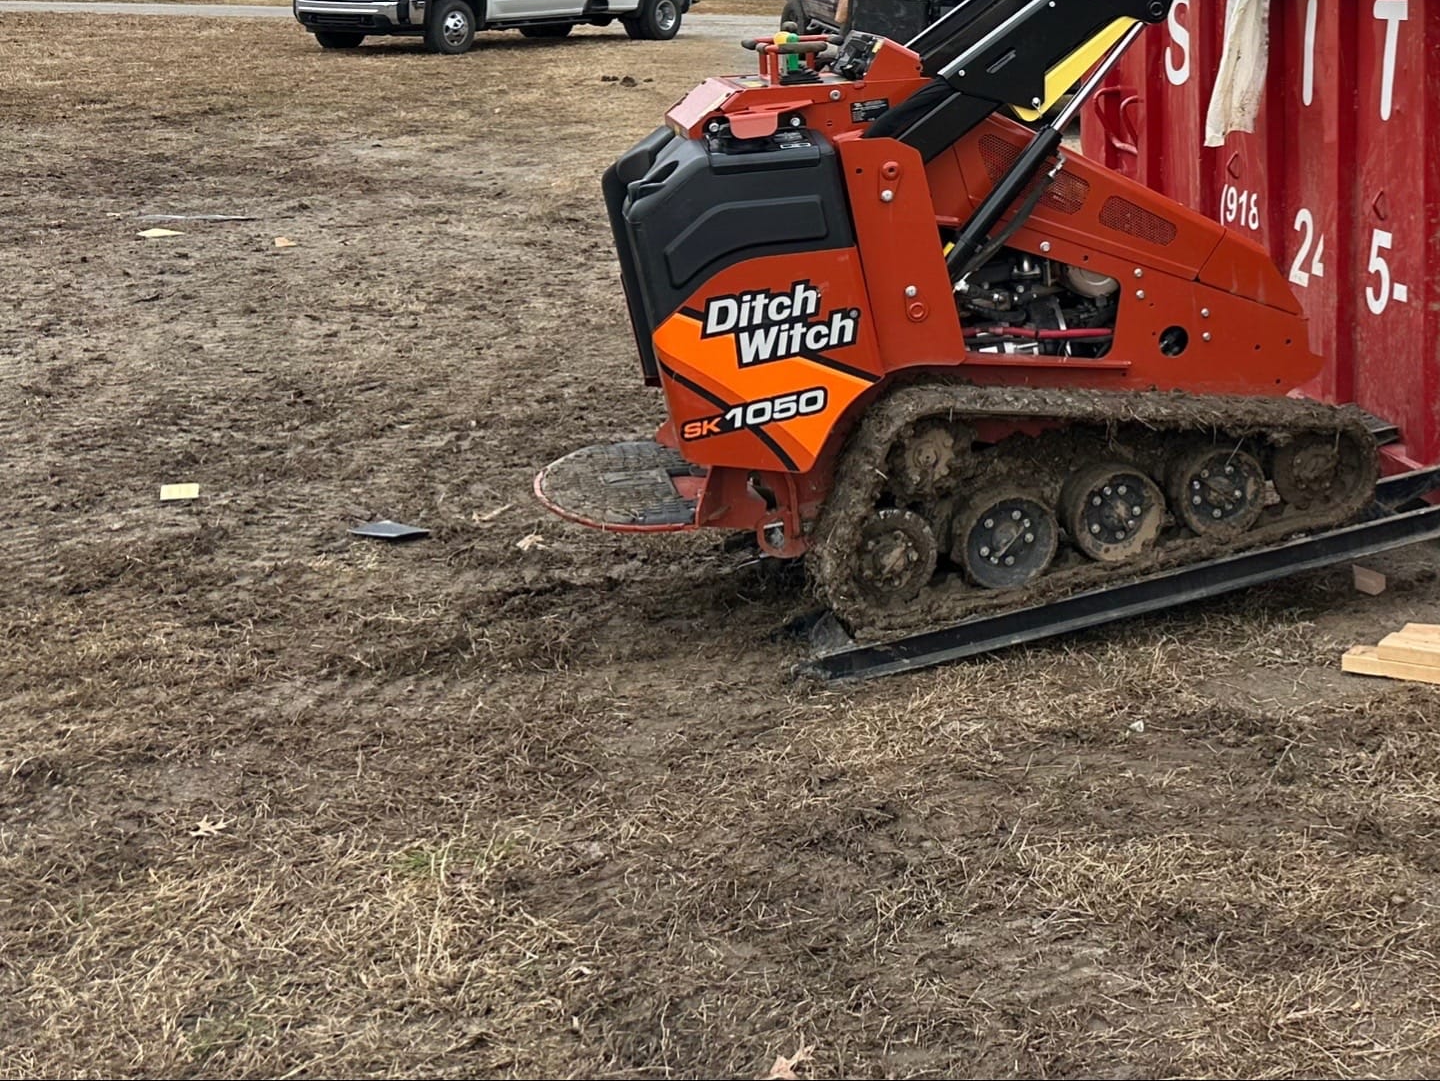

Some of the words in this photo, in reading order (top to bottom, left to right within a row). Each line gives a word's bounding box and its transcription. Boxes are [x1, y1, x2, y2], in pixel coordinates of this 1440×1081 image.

[706, 284, 818, 334] Ditch
[739, 313, 855, 364] Witch
[682, 418, 721, 438] SK
[725, 389, 825, 428] 1050
